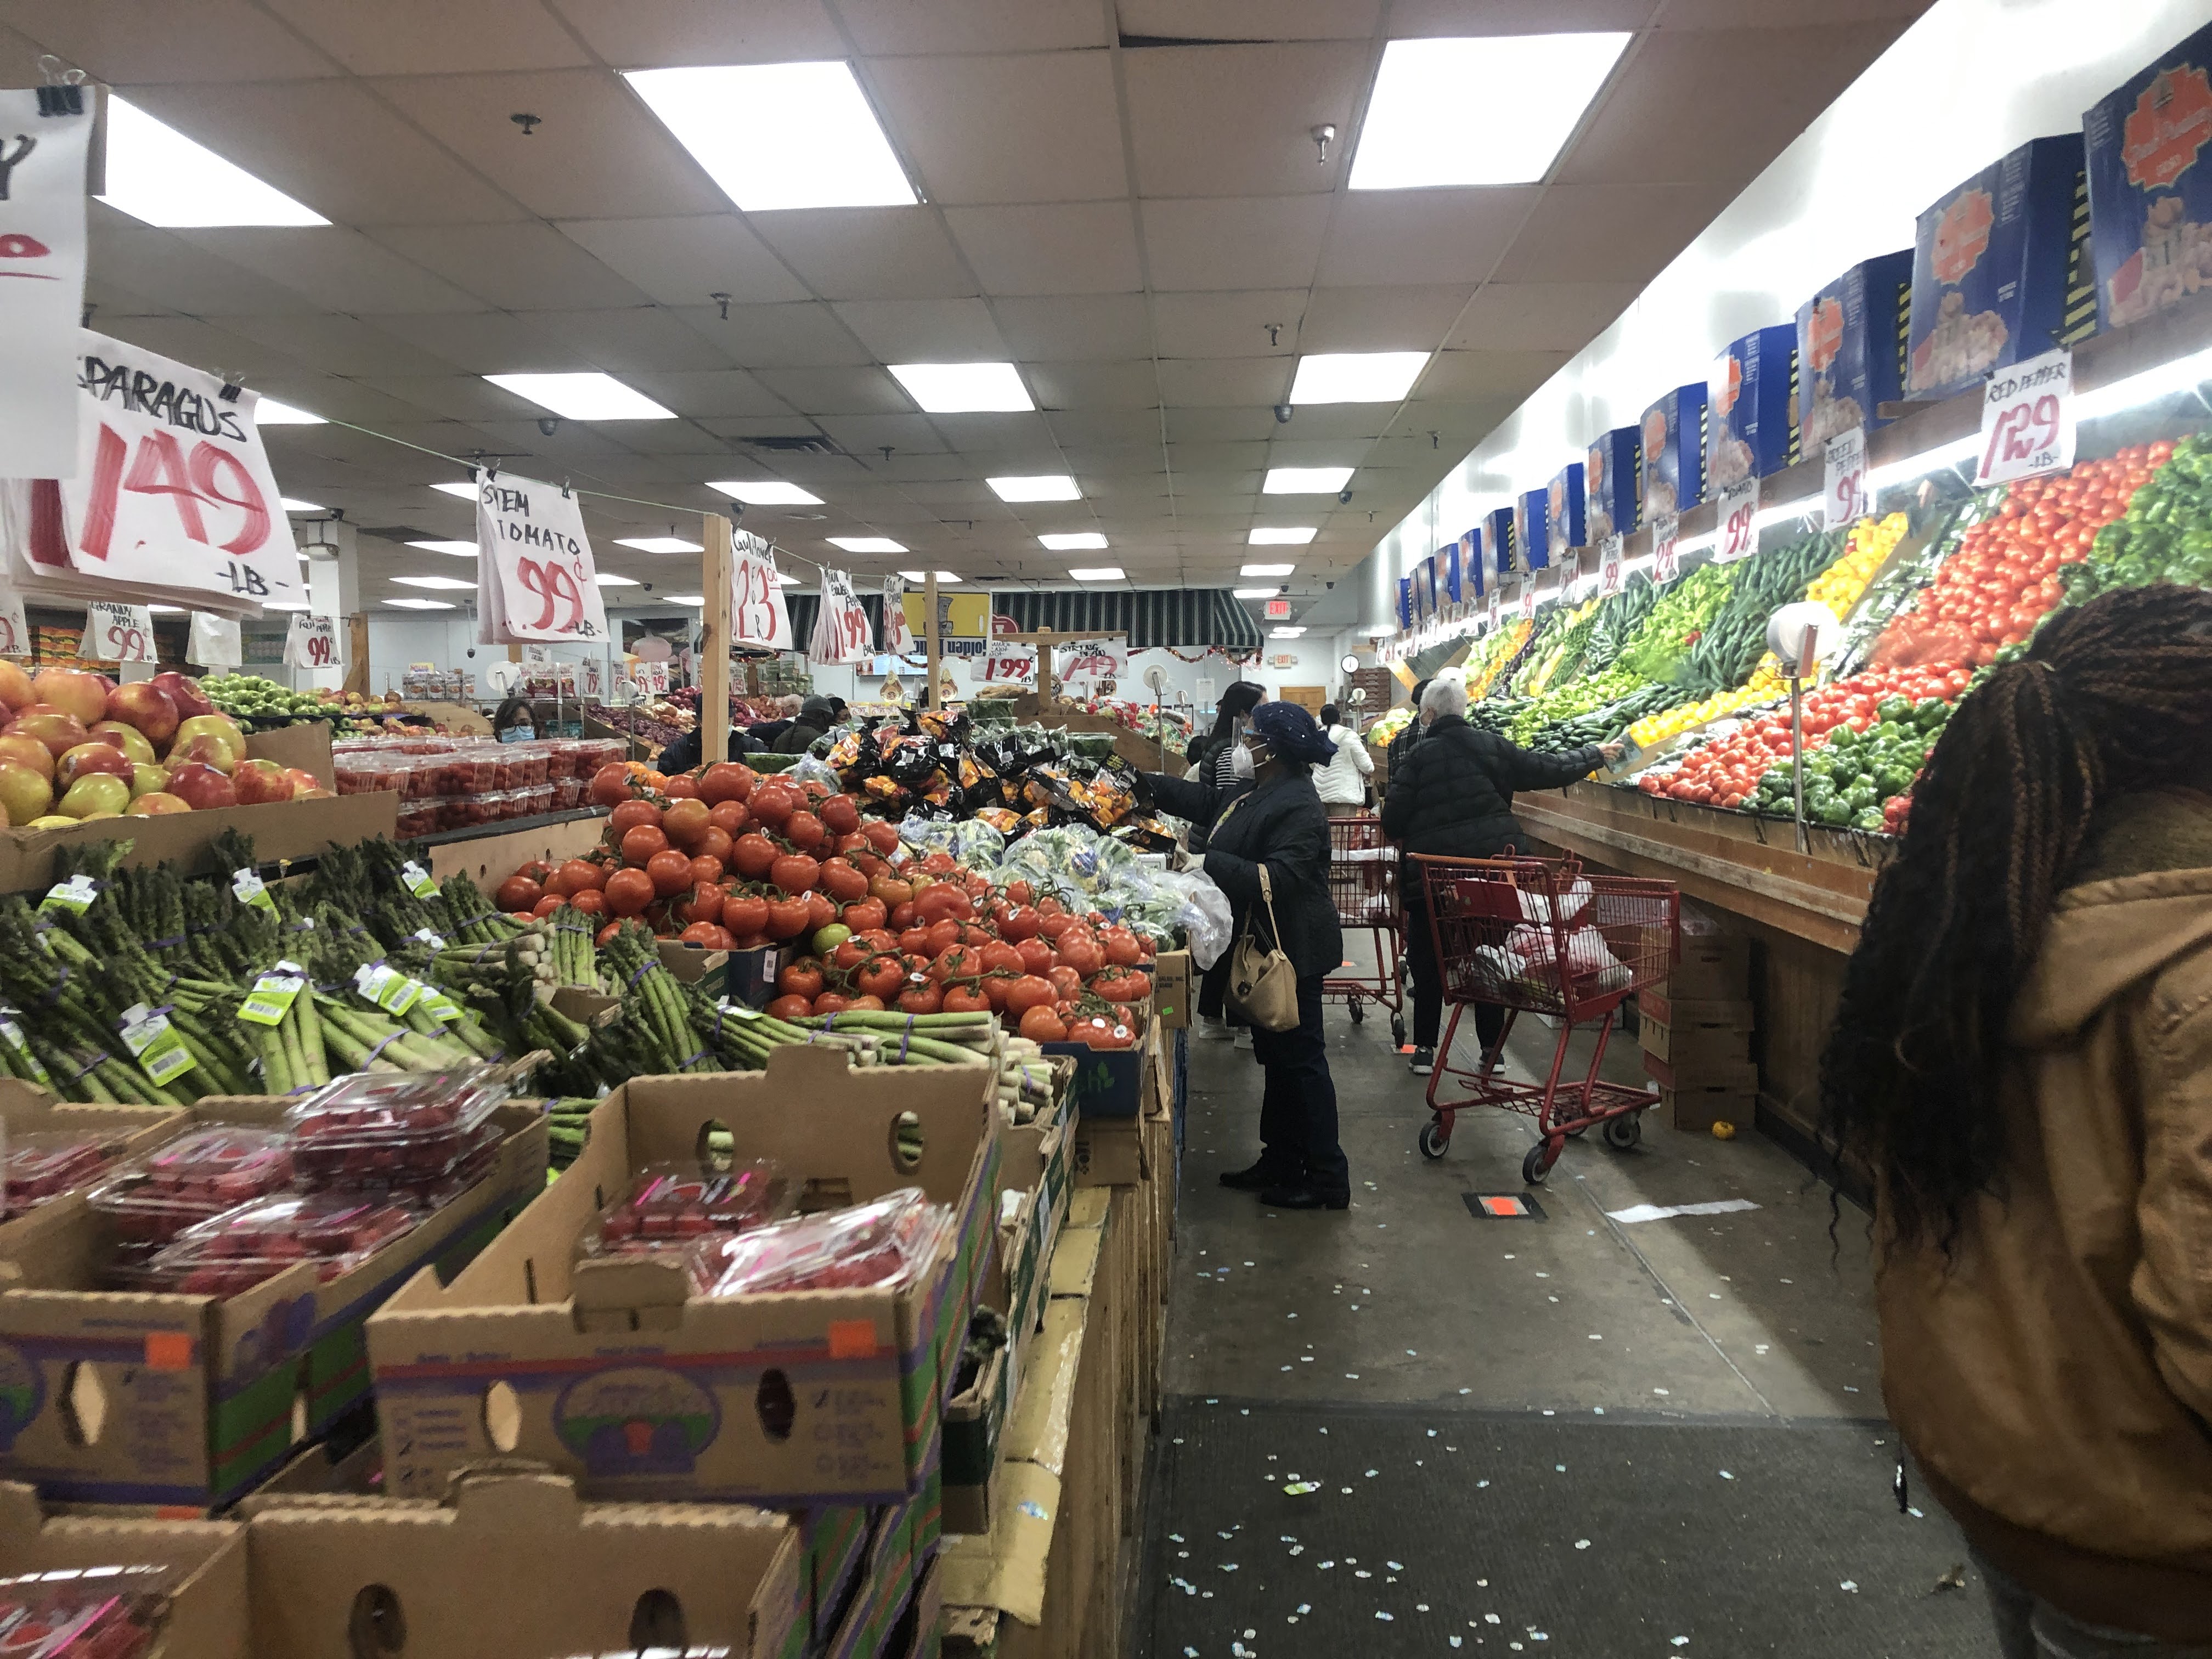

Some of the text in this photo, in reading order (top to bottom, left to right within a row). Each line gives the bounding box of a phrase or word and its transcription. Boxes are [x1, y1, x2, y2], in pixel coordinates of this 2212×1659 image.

[77, 356, 247, 442] PARAGUS
[482, 485, 529, 517] STEM
[497, 520, 580, 555] TOMATO
[1269, 601, 1288, 614] EXIT
[112, 616, 139, 628] APPLE
[1060, 644, 1099, 653] STRING
[1277, 655, 1289, 663] EXIT
